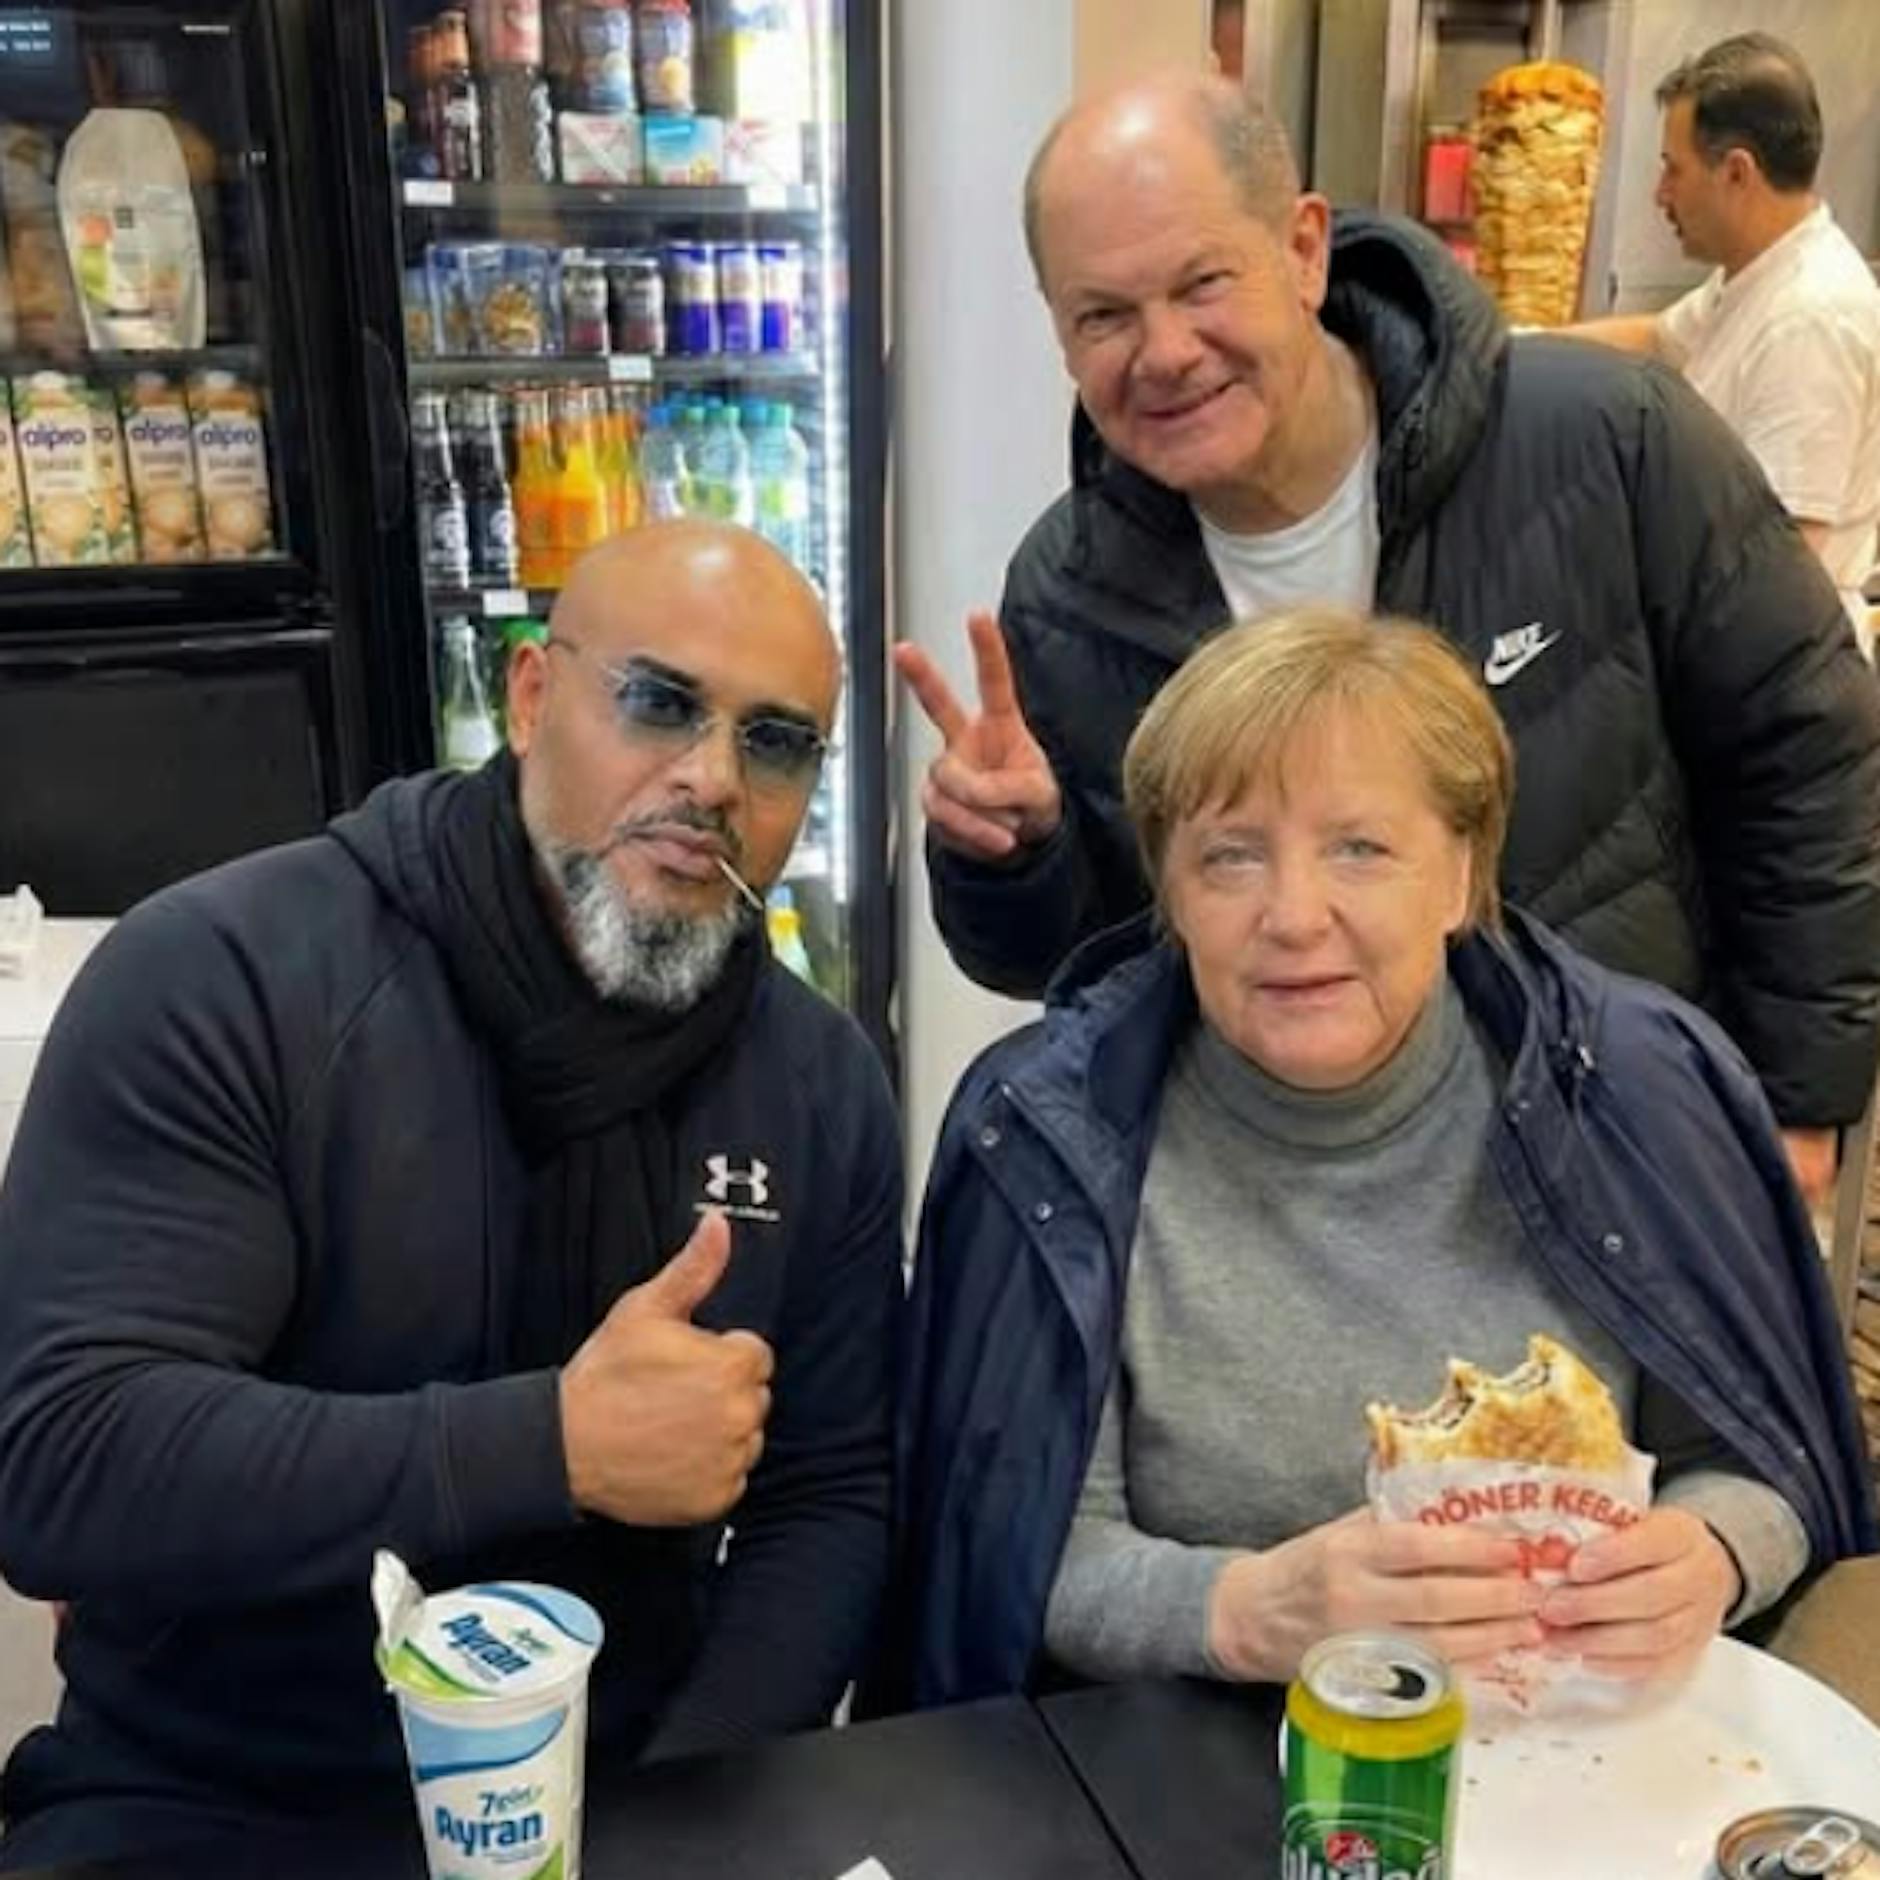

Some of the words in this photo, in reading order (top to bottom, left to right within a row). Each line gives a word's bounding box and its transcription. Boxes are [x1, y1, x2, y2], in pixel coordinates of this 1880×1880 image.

[23, 423, 86, 451] alpro
[131, 420, 187, 445] alpro
[201, 423, 257, 450] alpro
[1487, 621, 1544, 662] NIKE
[440, 1612, 531, 1676] Ayran
[435, 1806, 543, 1858] Ayran
